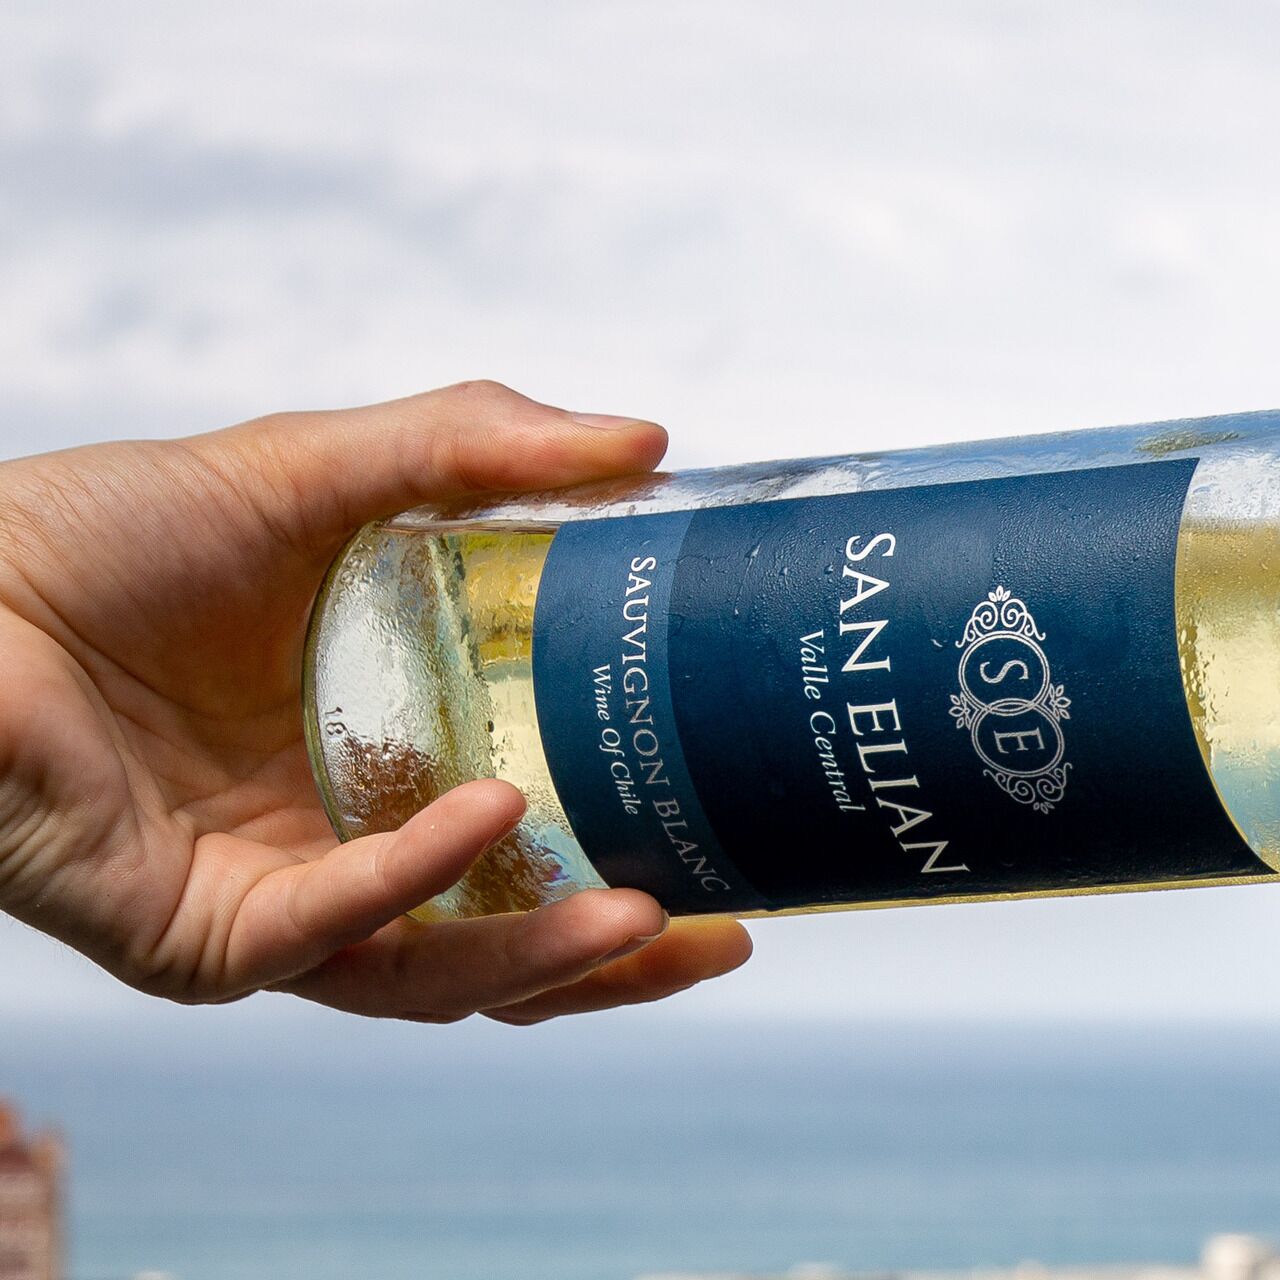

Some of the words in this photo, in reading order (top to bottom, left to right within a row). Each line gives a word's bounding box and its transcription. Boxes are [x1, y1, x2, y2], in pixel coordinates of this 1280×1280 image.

[839, 532, 896, 673] SAN
[592, 664, 612, 721] Wine
[799, 629, 830, 700] Valle
[979, 659, 1029, 684] S
[599, 728, 626, 758] Of
[621, 556, 670, 787] SAUVIGNON
[652, 797, 732, 892] BLANC
[993, 726, 1046, 754] E
[610, 761, 642, 815] Chile
[809, 711, 867, 813] Central
[846, 698, 971, 873] ELIAN
